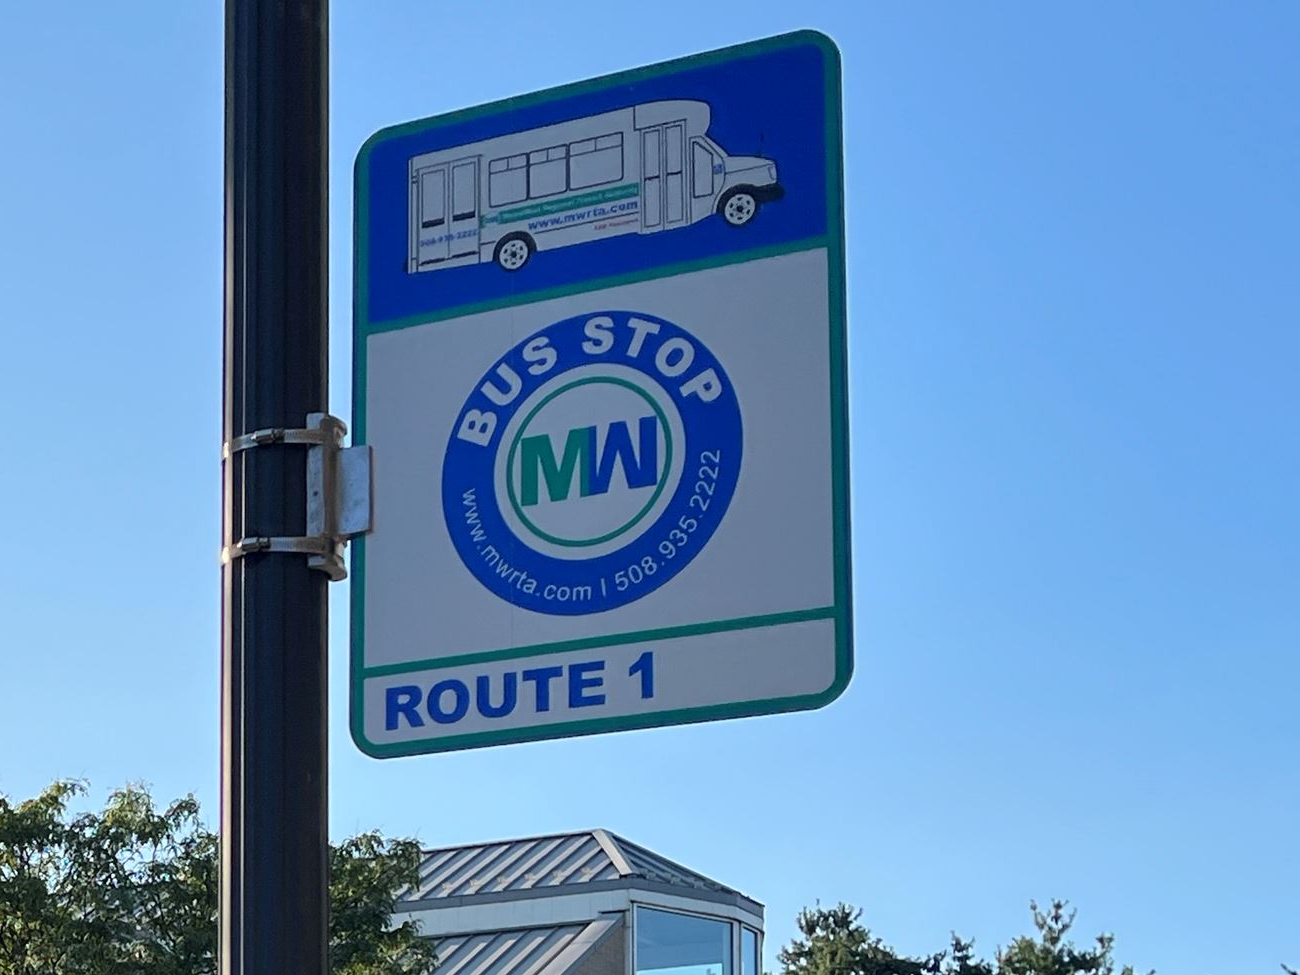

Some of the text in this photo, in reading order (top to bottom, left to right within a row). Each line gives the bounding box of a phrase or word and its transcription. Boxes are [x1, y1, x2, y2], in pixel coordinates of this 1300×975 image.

[528, 201, 638, 231] www.mwrta.com
[457, 315, 722, 447] BUS STOP
[520, 416, 658, 507] MW
[462, 488, 592, 602] www.mwrta.com
[615, 449, 721, 593] 508.935.2222
[384, 652, 654, 732] ROUTE 1
